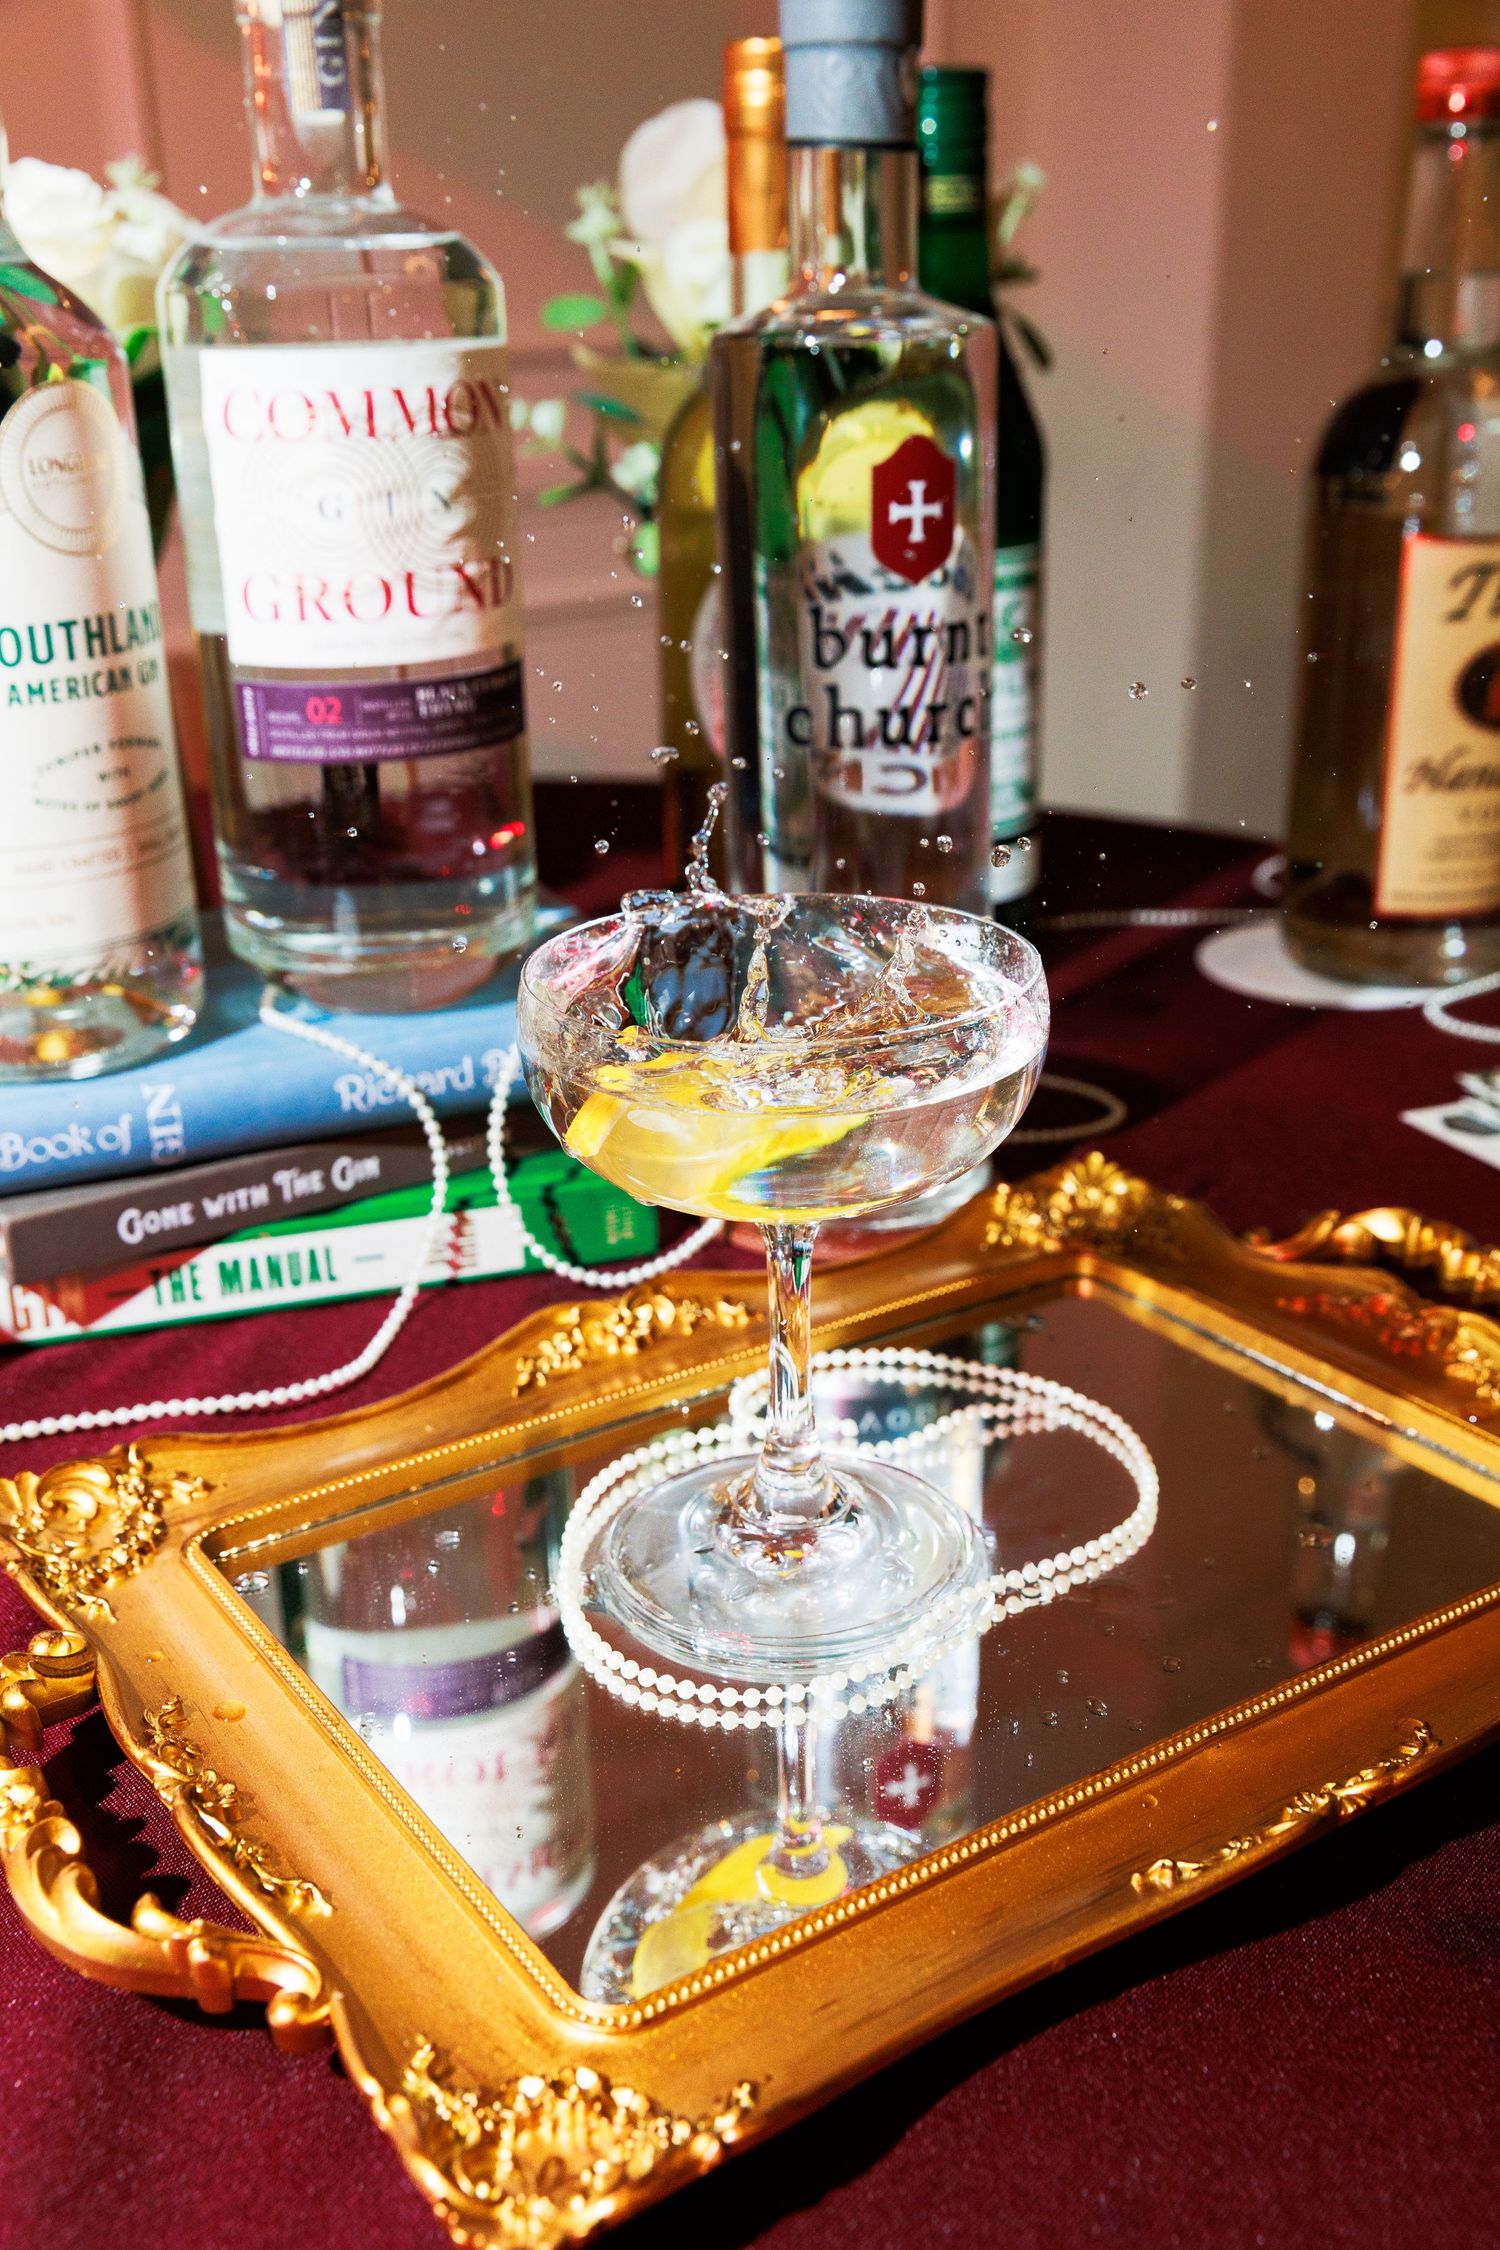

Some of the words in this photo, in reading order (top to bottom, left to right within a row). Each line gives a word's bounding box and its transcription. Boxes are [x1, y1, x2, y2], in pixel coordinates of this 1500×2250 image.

[243, 560, 513, 621] GROUND
[8, 661, 133, 707] AMERICAN
[304, 695, 342, 725] 02
[786, 672, 989, 748] churc
[334, 1054, 476, 1112] Ricard
[0, 1122, 96, 1172] Book
[96, 1112, 133, 1156] of
[141, 1083, 187, 1166] GIN
[150, 1263, 203, 1306] THE
[217, 1246, 337, 1297] MANUAL
